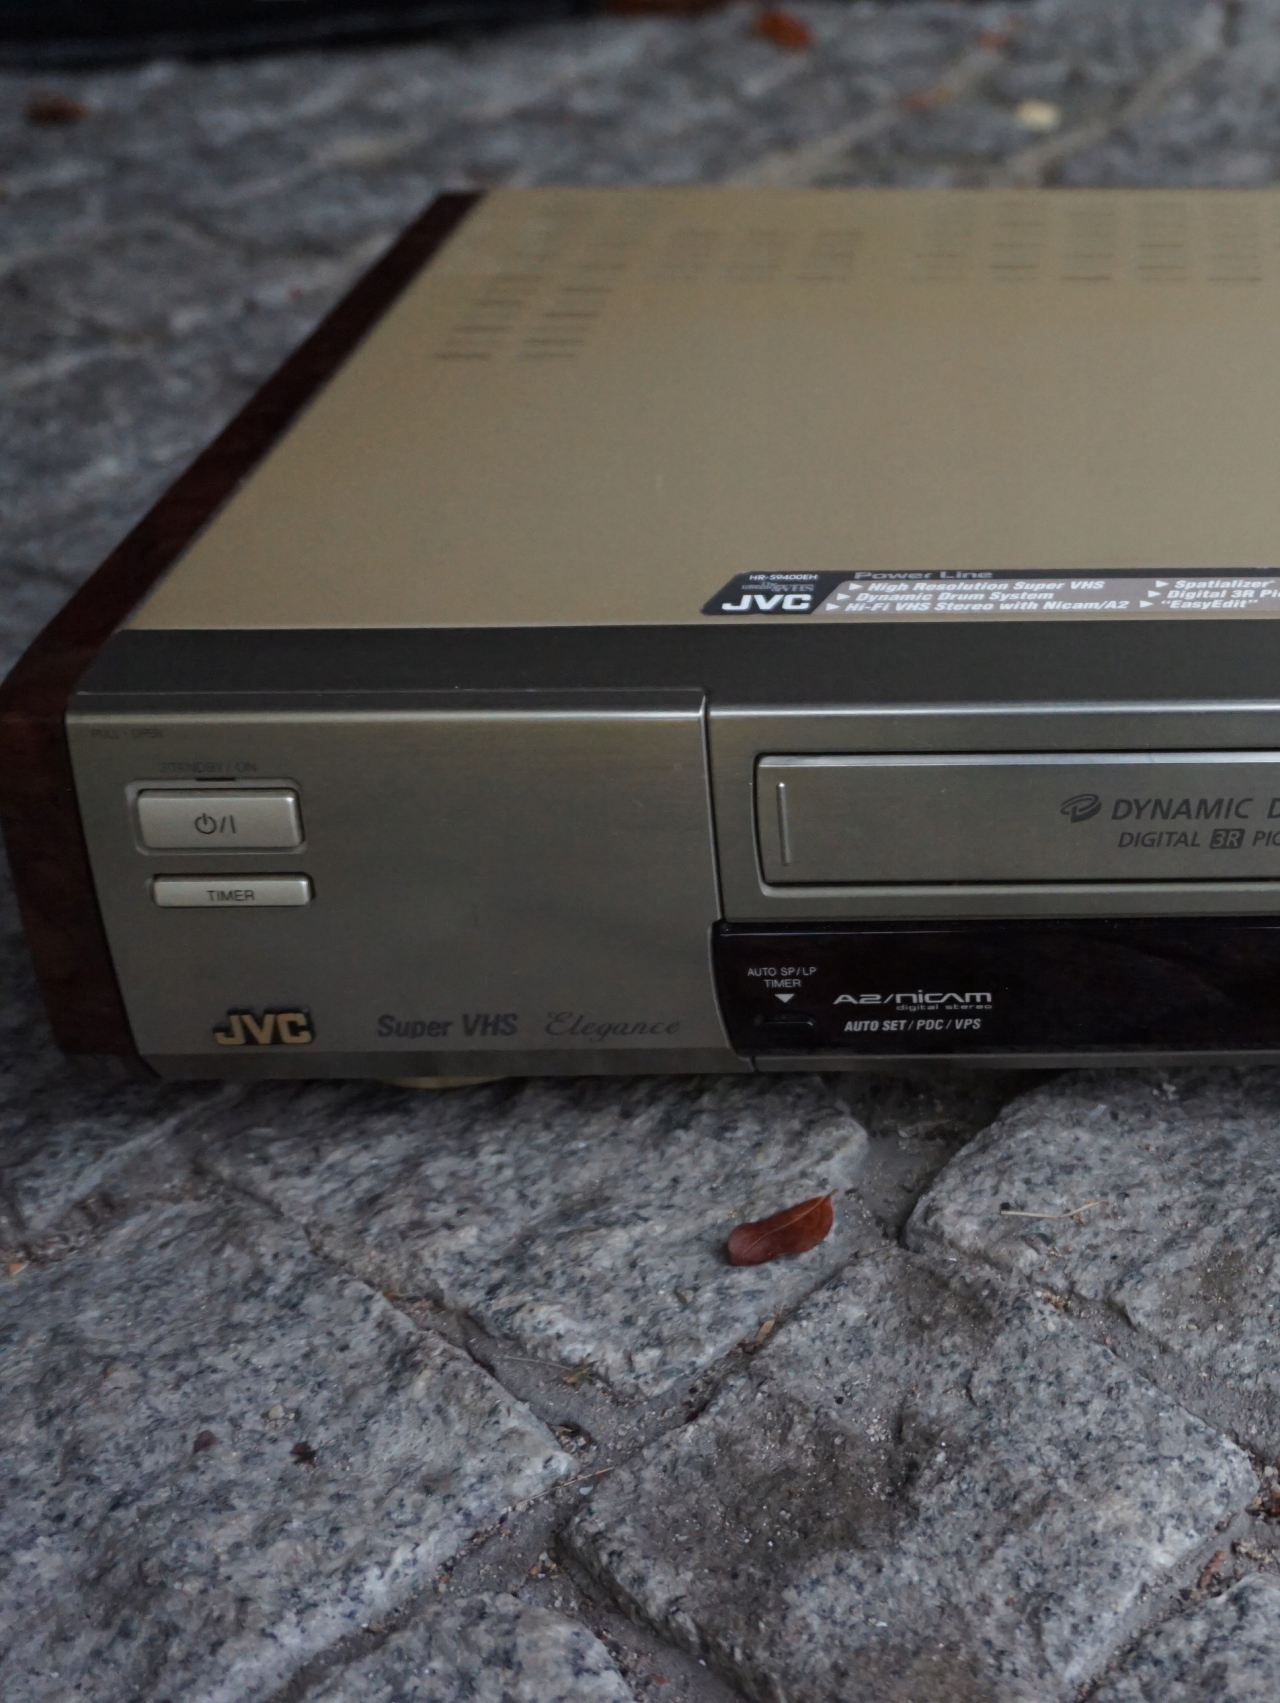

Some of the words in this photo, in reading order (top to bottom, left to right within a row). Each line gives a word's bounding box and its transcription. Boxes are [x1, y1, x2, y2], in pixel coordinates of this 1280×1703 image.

[854, 571, 932, 580] Power
[940, 571, 993, 579] Line
[867, 583, 909, 593] High
[912, 582, 1008, 591] Resolution
[1013, 581, 1065, 591] Super
[1070, 580, 1106, 590] VHS
[1174, 580, 1271, 590] Spatializer
[855, 592, 933, 602] Dynamic
[937, 592, 985, 601] Drum
[988, 591, 1055, 601] System
[1167, 590, 1227, 600] Digital
[1231, 589, 1255, 598] 3R
[722, 594, 812, 610] JVC
[845, 602, 891, 612] Hi-Fi
[895, 602, 930, 611] VHS
[934, 602, 994, 611] Stereo
[999, 601, 1039, 610] with
[1042, 600, 1130, 610] Nicam/A2
[1111, 798, 1253, 820] DYNAMIC
[1118, 831, 1201, 848] DIGITAL
[1210, 829, 1244, 848] 3R
[207, 890, 255, 901] TIMER
[747, 967, 777, 976] AUTO
[764, 979, 802, 988] TIMER
[896, 1003, 939, 1012] digital
[214, 1010, 313, 1045] JVC
[376, 1013, 454, 1039] Super
[461, 1013, 518, 1037] VHS
[545, 1011, 681, 1043] Elegance
[844, 1020, 878, 1032] AUTO
